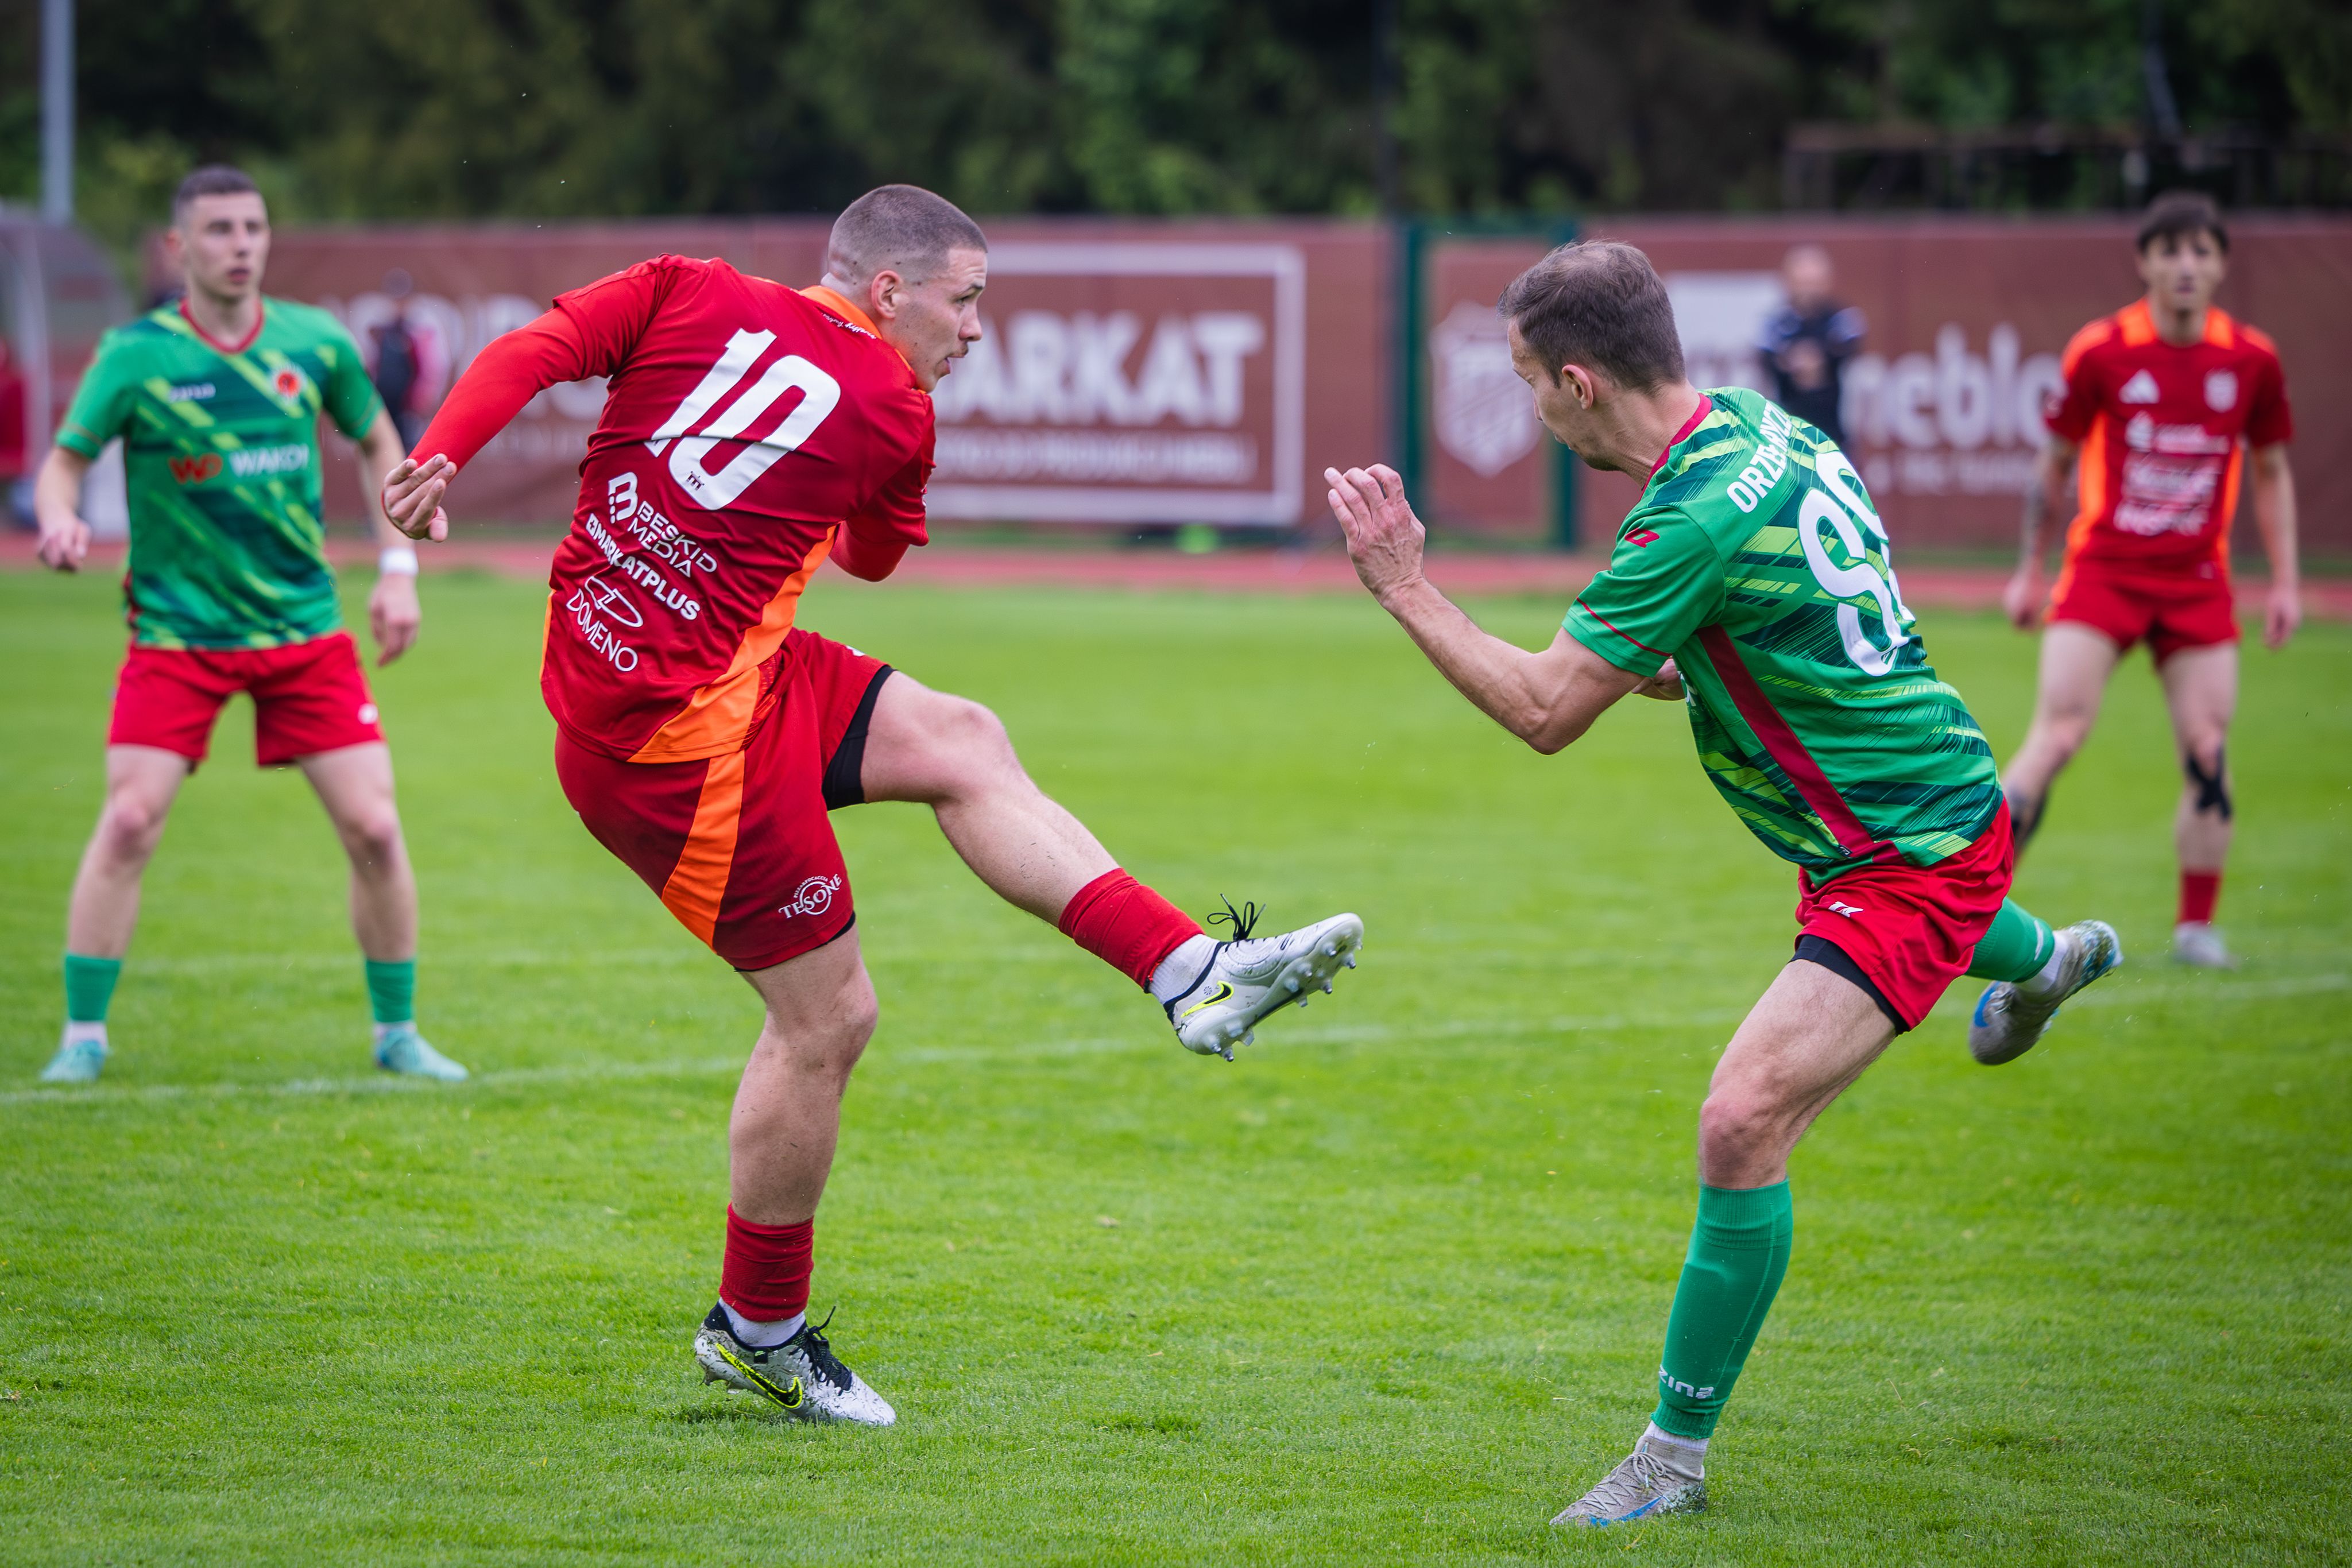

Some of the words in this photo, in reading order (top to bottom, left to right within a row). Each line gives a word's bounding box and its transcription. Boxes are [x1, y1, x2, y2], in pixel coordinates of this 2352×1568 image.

[937, 308, 1265, 428] ARKAT
[644, 328, 841, 510] 10
[627, 517, 691, 578] MEDIA
[637, 501, 717, 572] BESKID
[566, 588, 638, 672] DOMENO
[778, 873, 842, 919] TESONE
